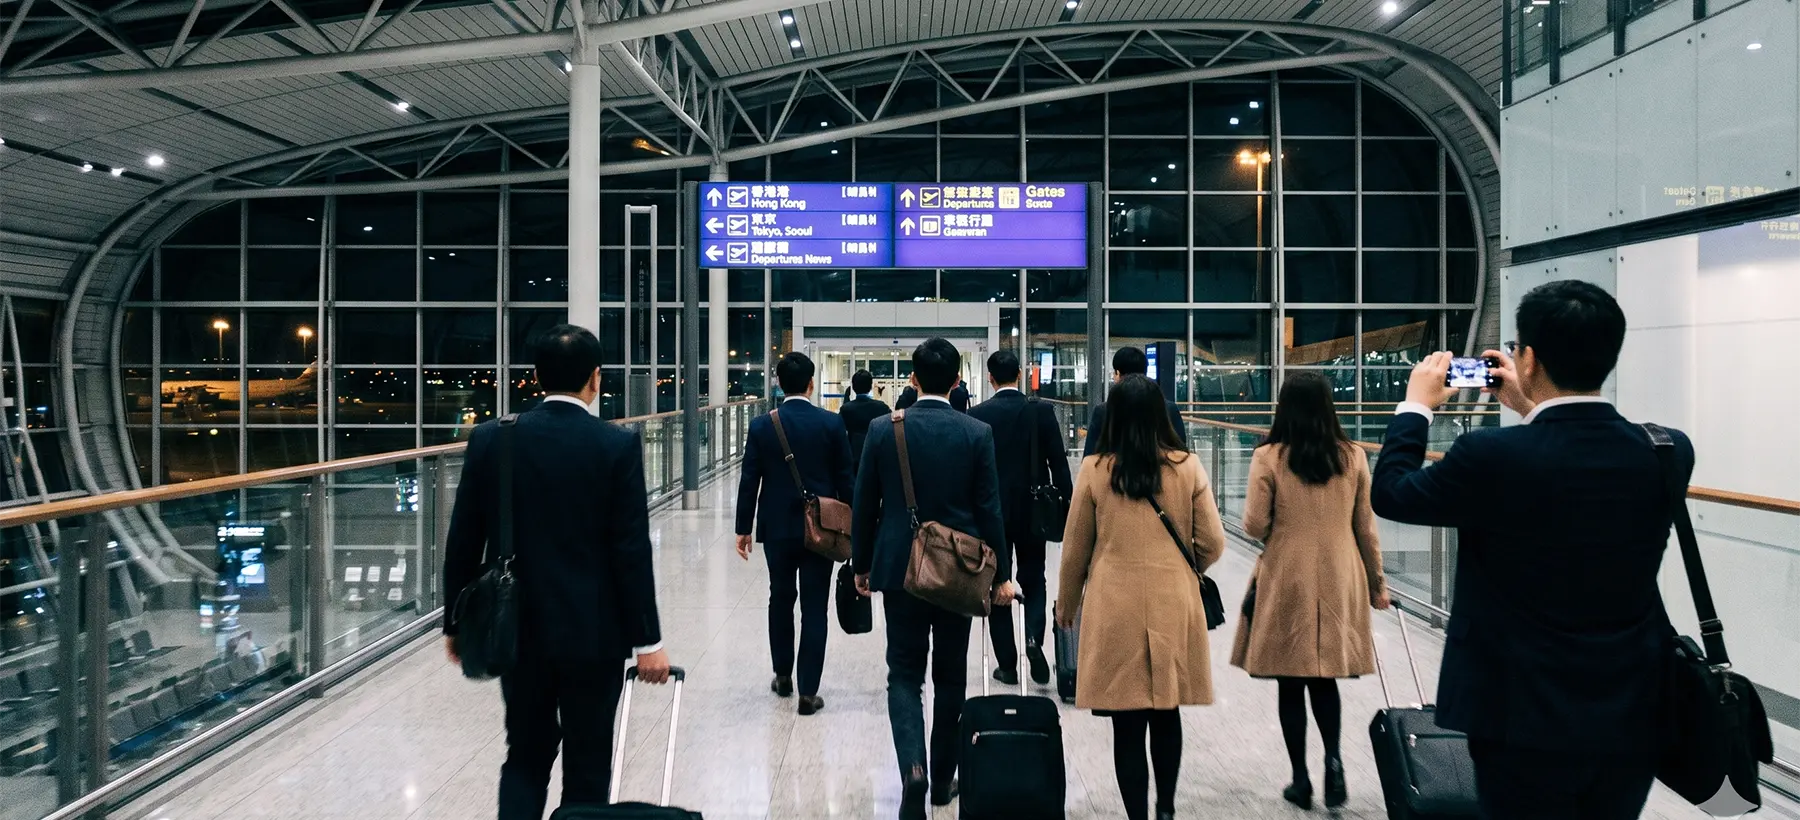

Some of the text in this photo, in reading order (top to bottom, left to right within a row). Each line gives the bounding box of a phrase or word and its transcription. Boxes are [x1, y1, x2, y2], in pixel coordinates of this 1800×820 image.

[1025, 185, 1066, 197] Gates
[751, 199, 807, 210] Hong Kong
[751, 226, 783, 238] Tokyo,
[751, 253, 833, 266] Departures News
